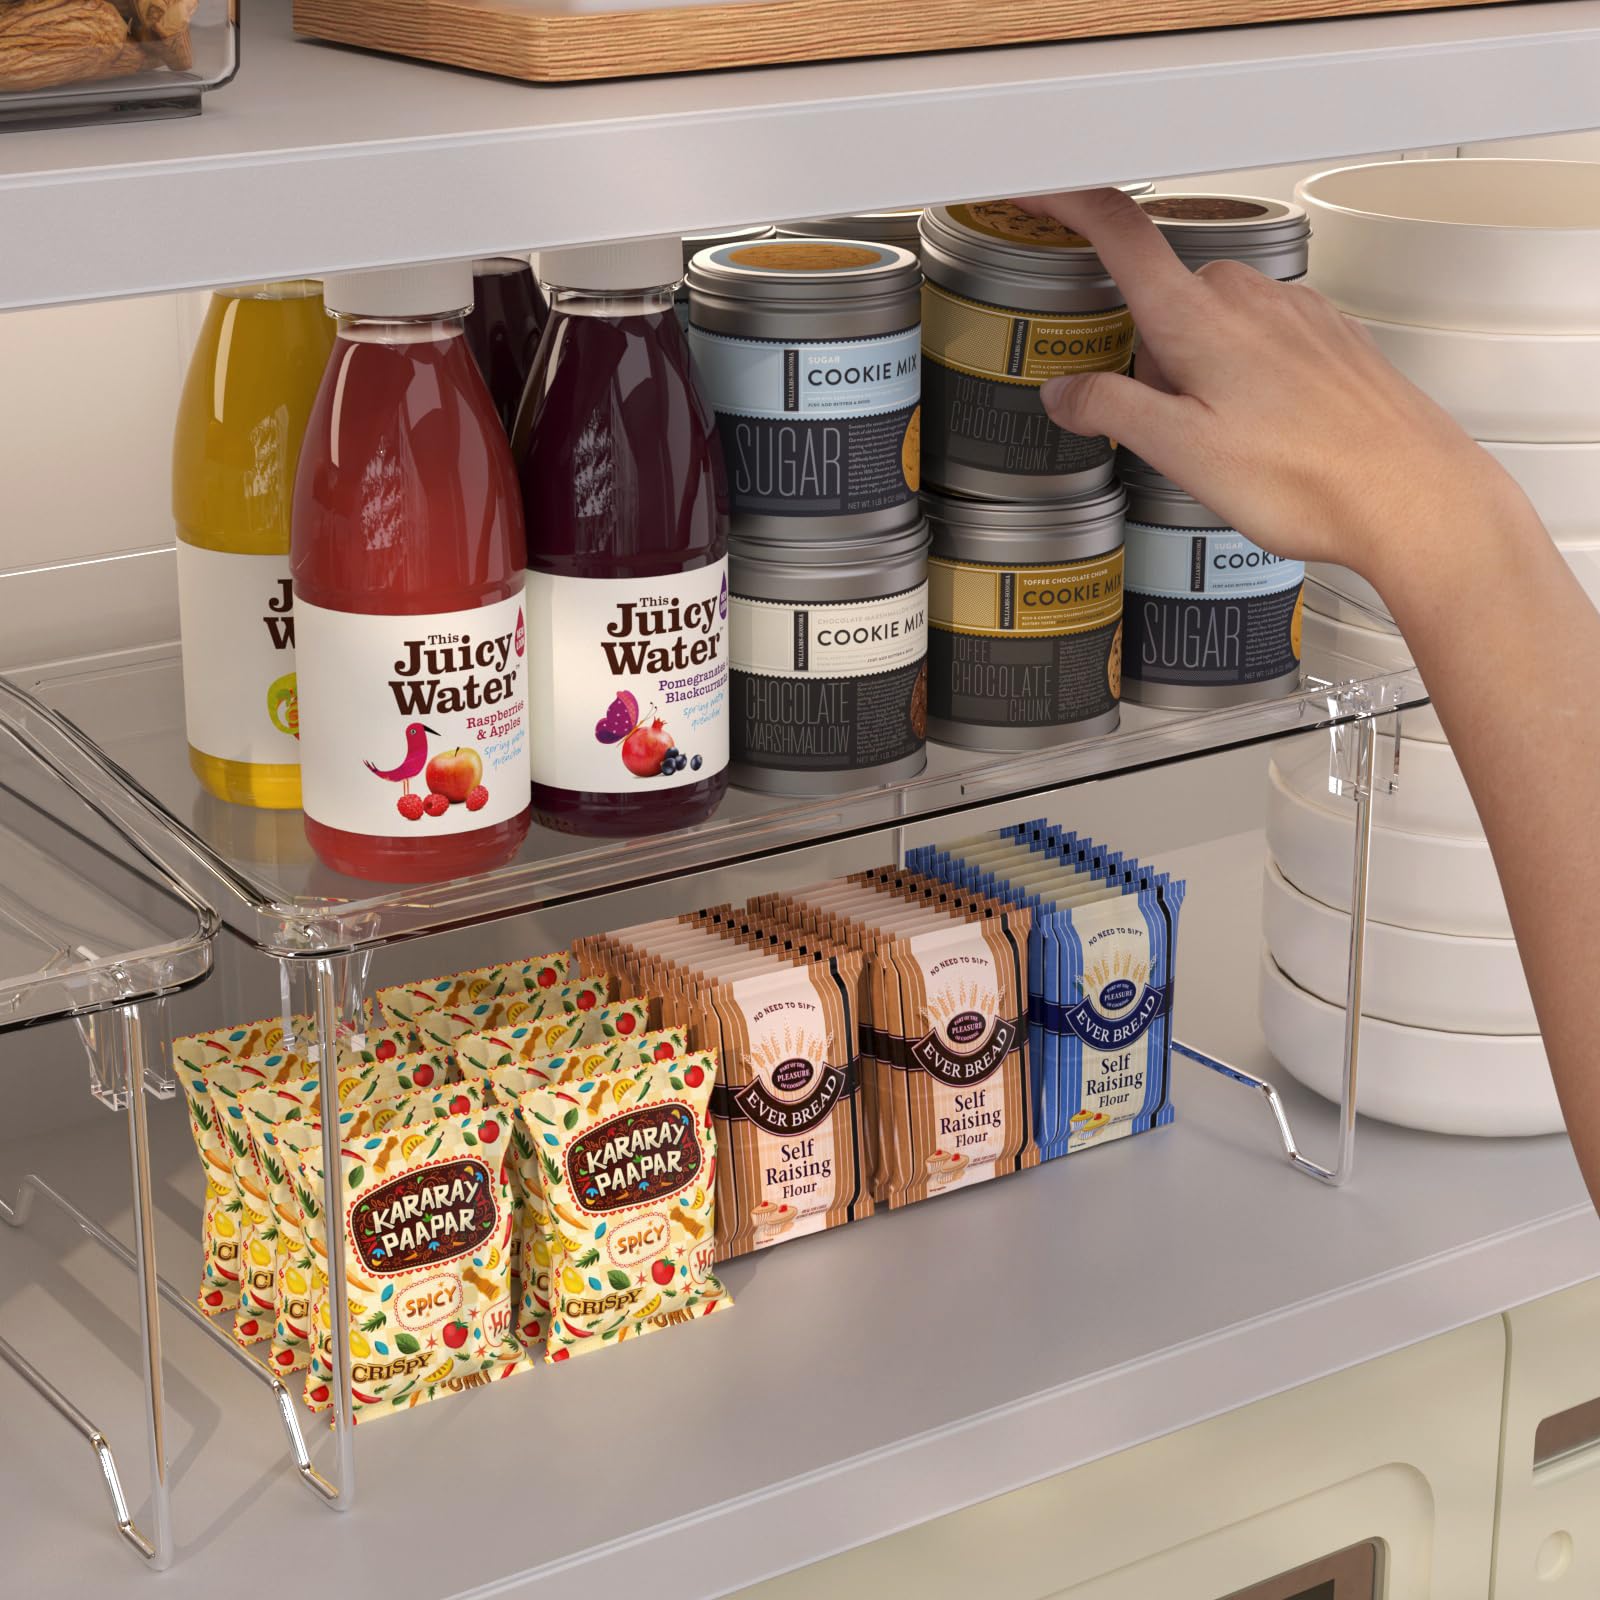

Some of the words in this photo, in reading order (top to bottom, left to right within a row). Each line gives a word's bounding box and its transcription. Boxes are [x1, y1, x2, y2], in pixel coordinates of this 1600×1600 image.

[1034, 335, 1112, 356] COOKIE
[1037, 327, 1063, 335] TOFFEE
[1065, 327, 1104, 335] CHOCOLATE
[807, 362, 892, 386] COOKIE
[896, 353, 917, 377] MIX
[951, 401, 1053, 447] CHOCOLATE
[735, 423, 841, 497] SUGAR
[1007, 446, 1049, 471] CHUNK
[1051, 574, 1090, 585] CHOCOLATE
[640, 596, 669, 607] This
[1023, 583, 1100, 607] COOKIE
[607, 596, 718, 638] Juicy
[817, 621, 899, 646] COOKIE
[904, 610, 924, 634] MIX
[427, 633, 459, 646] This
[1142, 602, 1240, 668] SUGAR
[394, 632, 513, 677] Juicy
[601, 633, 720, 675] Water
[388, 670, 517, 715] Water
[952, 661, 1053, 698] CHOCOLATE
[466, 700, 524, 728] Raspberries
[746, 677, 850, 725] CHOCOLATE
[1009, 699, 1051, 722] CHUNK
[477, 729, 487, 740] &
[489, 716, 521, 738] Apples
[746, 720, 850, 755] MARSHMALLOW
[930, 966, 940, 976] NO
[939, 958, 958, 969] NEED
[753, 1011, 764, 1023] NO
[763, 1003, 783, 1015] NEED
[1075, 1008, 1109, 1043] EVER
[1113, 996, 1155, 1043] BREAD
[951, 1021, 983, 1035] PLEASURE
[922, 1041, 962, 1078] EVER
[965, 1027, 1007, 1079] BREAD
[1101, 1053, 1131, 1075] Self
[777, 1069, 810, 1082] PLEASURE
[1086, 1071, 1143, 1096] Raising
[746, 1089, 788, 1128] EVER
[792, 1075, 836, 1127] BREAD
[954, 1089, 986, 1113] Self
[1099, 1091, 1130, 1108] Flour
[940, 1109, 1001, 1135] Raising
[585, 1121, 686, 1174] KARARAY
[781, 1138, 815, 1163] Self
[955, 1130, 988, 1148] Flour
[594, 1150, 683, 1197] PAAPAR
[765, 1158, 831, 1186] Raising
[782, 1180, 817, 1199] Flour
[372, 1178, 480, 1234] KARARAY
[380, 1208, 476, 1258] PAAPAR
[617, 1224, 665, 1256] SPICY
[405, 1284, 457, 1318] SPICY
[566, 1287, 644, 1318] CRISPY
[352, 1351, 434, 1384] CRISPY
